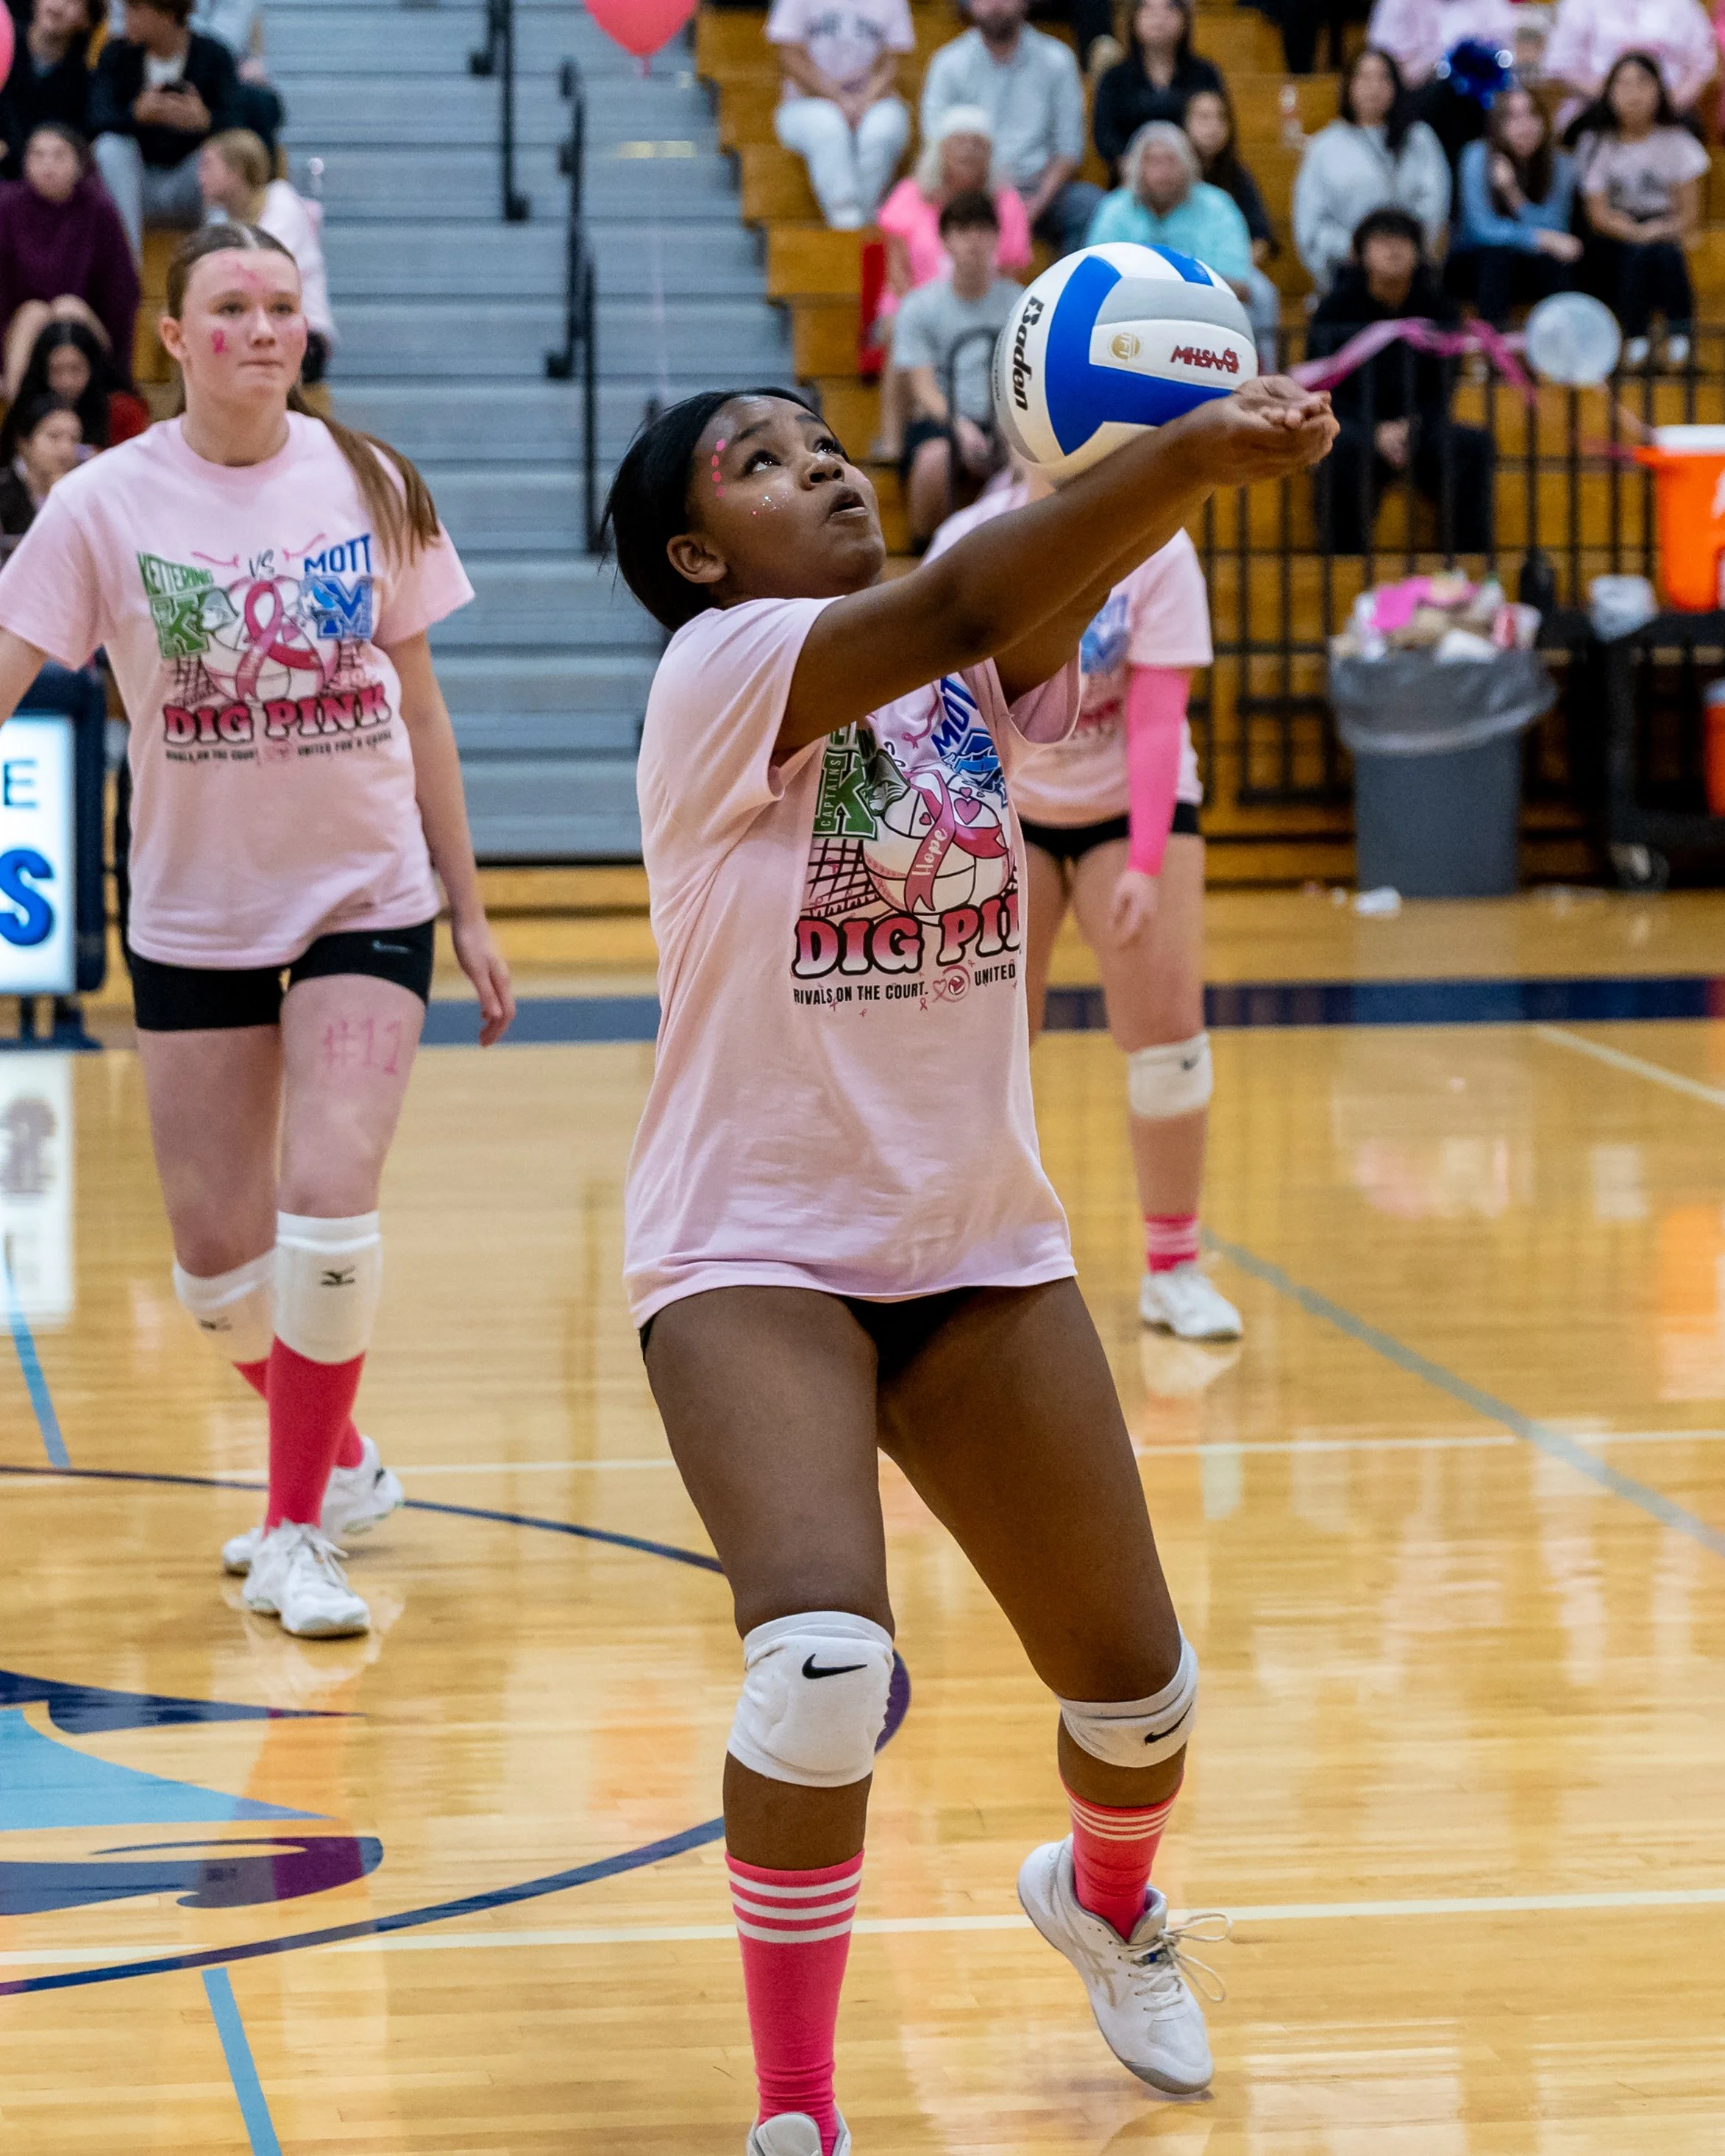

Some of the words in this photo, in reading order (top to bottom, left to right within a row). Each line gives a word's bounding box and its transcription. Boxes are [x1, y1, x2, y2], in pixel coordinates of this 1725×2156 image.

[1013, 296, 1044, 410] Baden
[249, 549, 274, 580] VS
[304, 533, 371, 572] MOTT
[163, 703, 254, 744] DIG
[263, 683, 392, 738] PINK
[931, 675, 978, 757] MOT
[3, 758, 38, 808] E
[821, 759, 842, 827] CAPTAINS
[911, 828, 947, 875] Hope
[0, 849, 54, 946] S
[792, 913, 925, 979] DIG
[936, 893, 1020, 967] PI
[793, 986, 833, 1006] RIVALS
[836, 986, 853, 1002] ON
[857, 985, 881, 1001] THE
[885, 981, 928, 1000] COURT.
[974, 963, 1016, 986] UNITED
